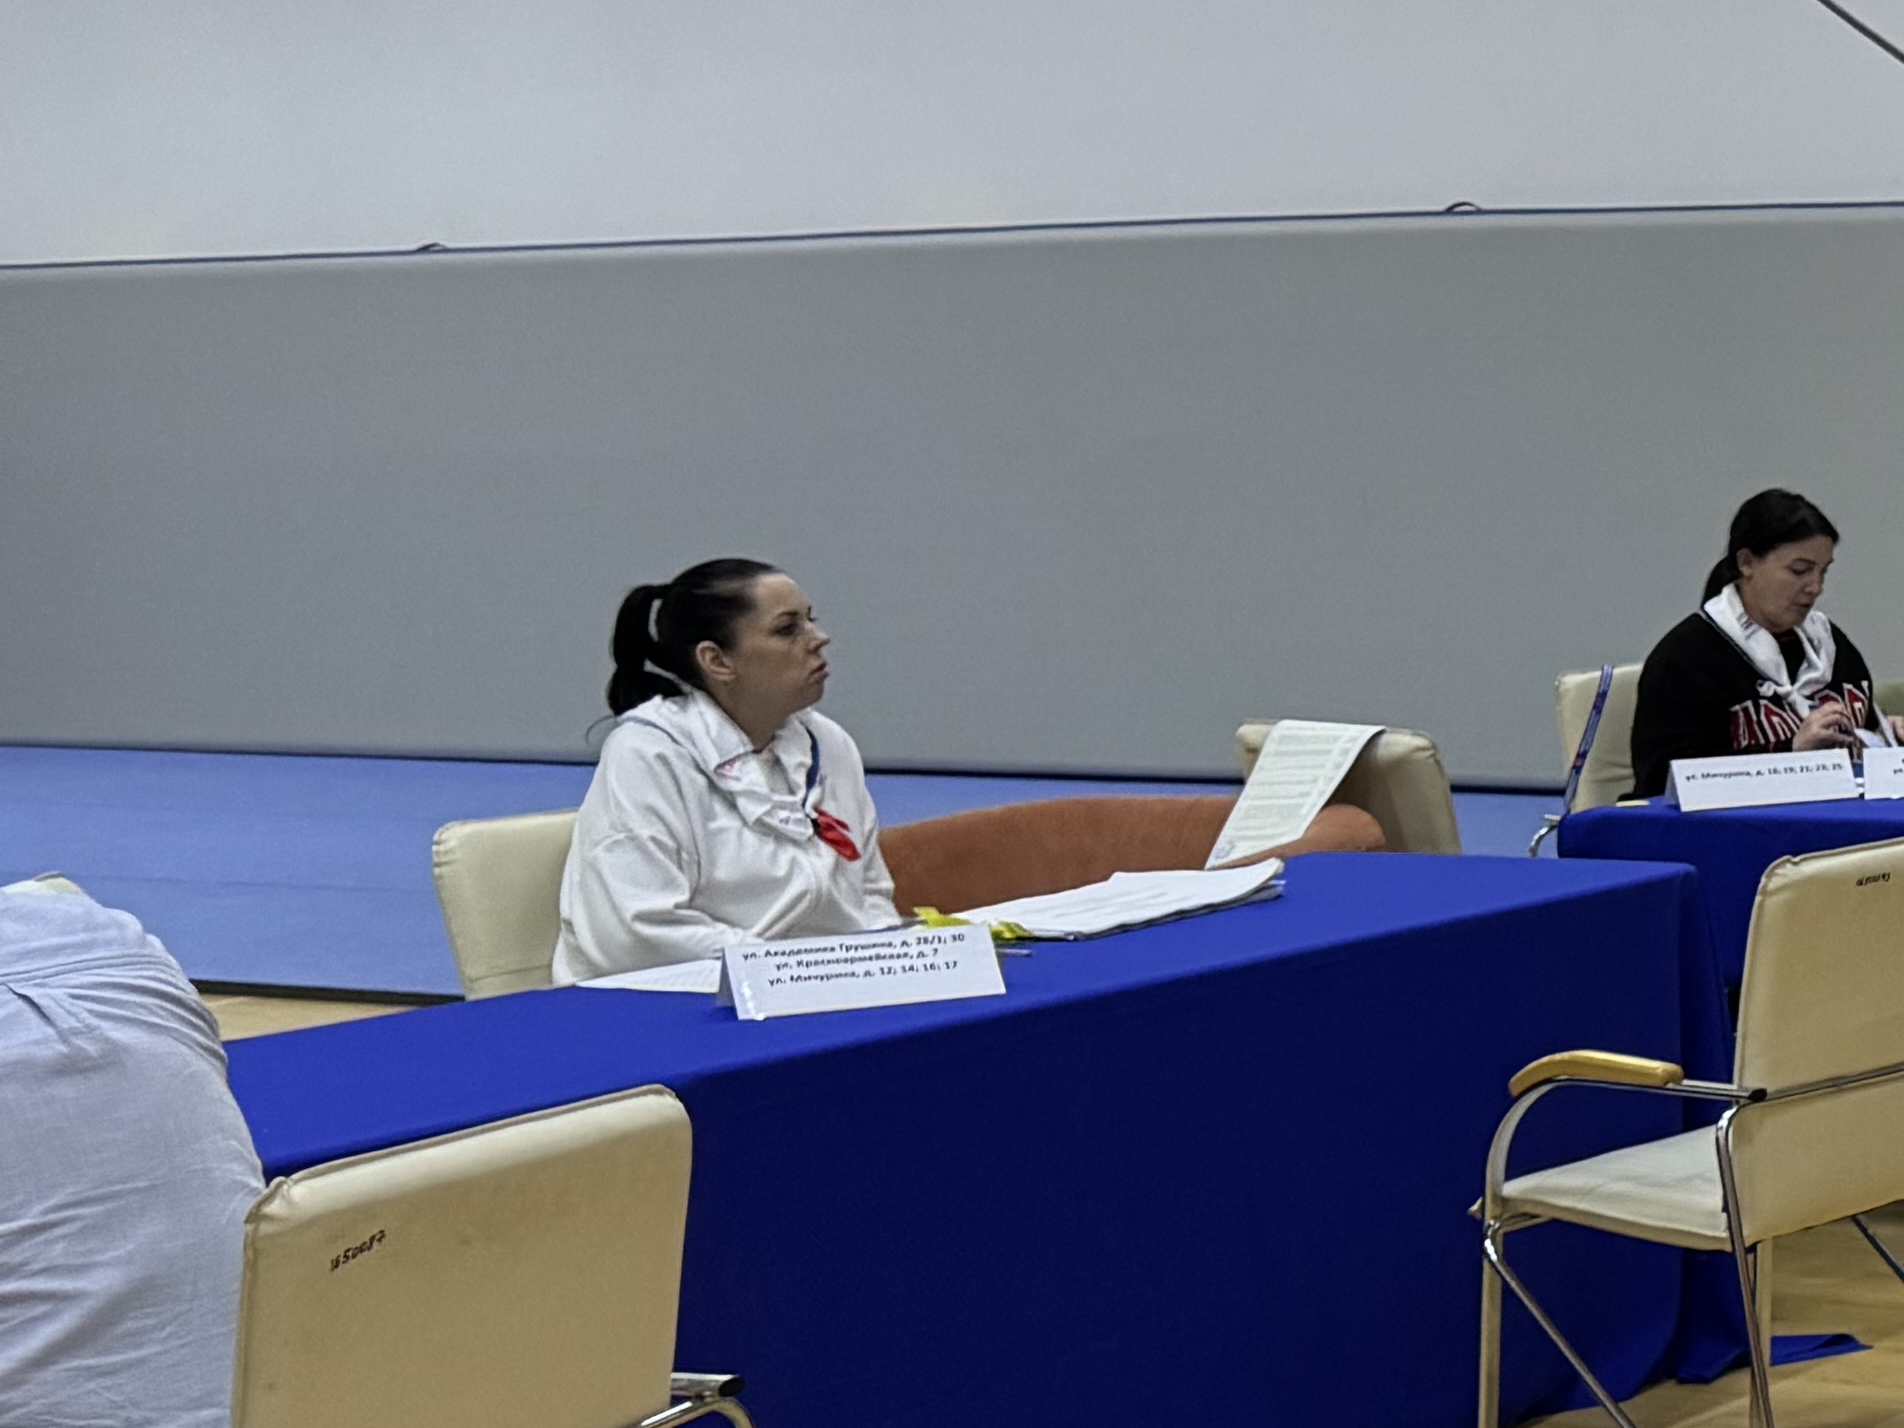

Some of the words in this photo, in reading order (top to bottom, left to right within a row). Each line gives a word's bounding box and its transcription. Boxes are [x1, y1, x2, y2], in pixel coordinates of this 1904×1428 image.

[742, 951, 761, 960] ул.
[775, 962, 793, 972] ул.
[768, 977, 786, 987] ул.
